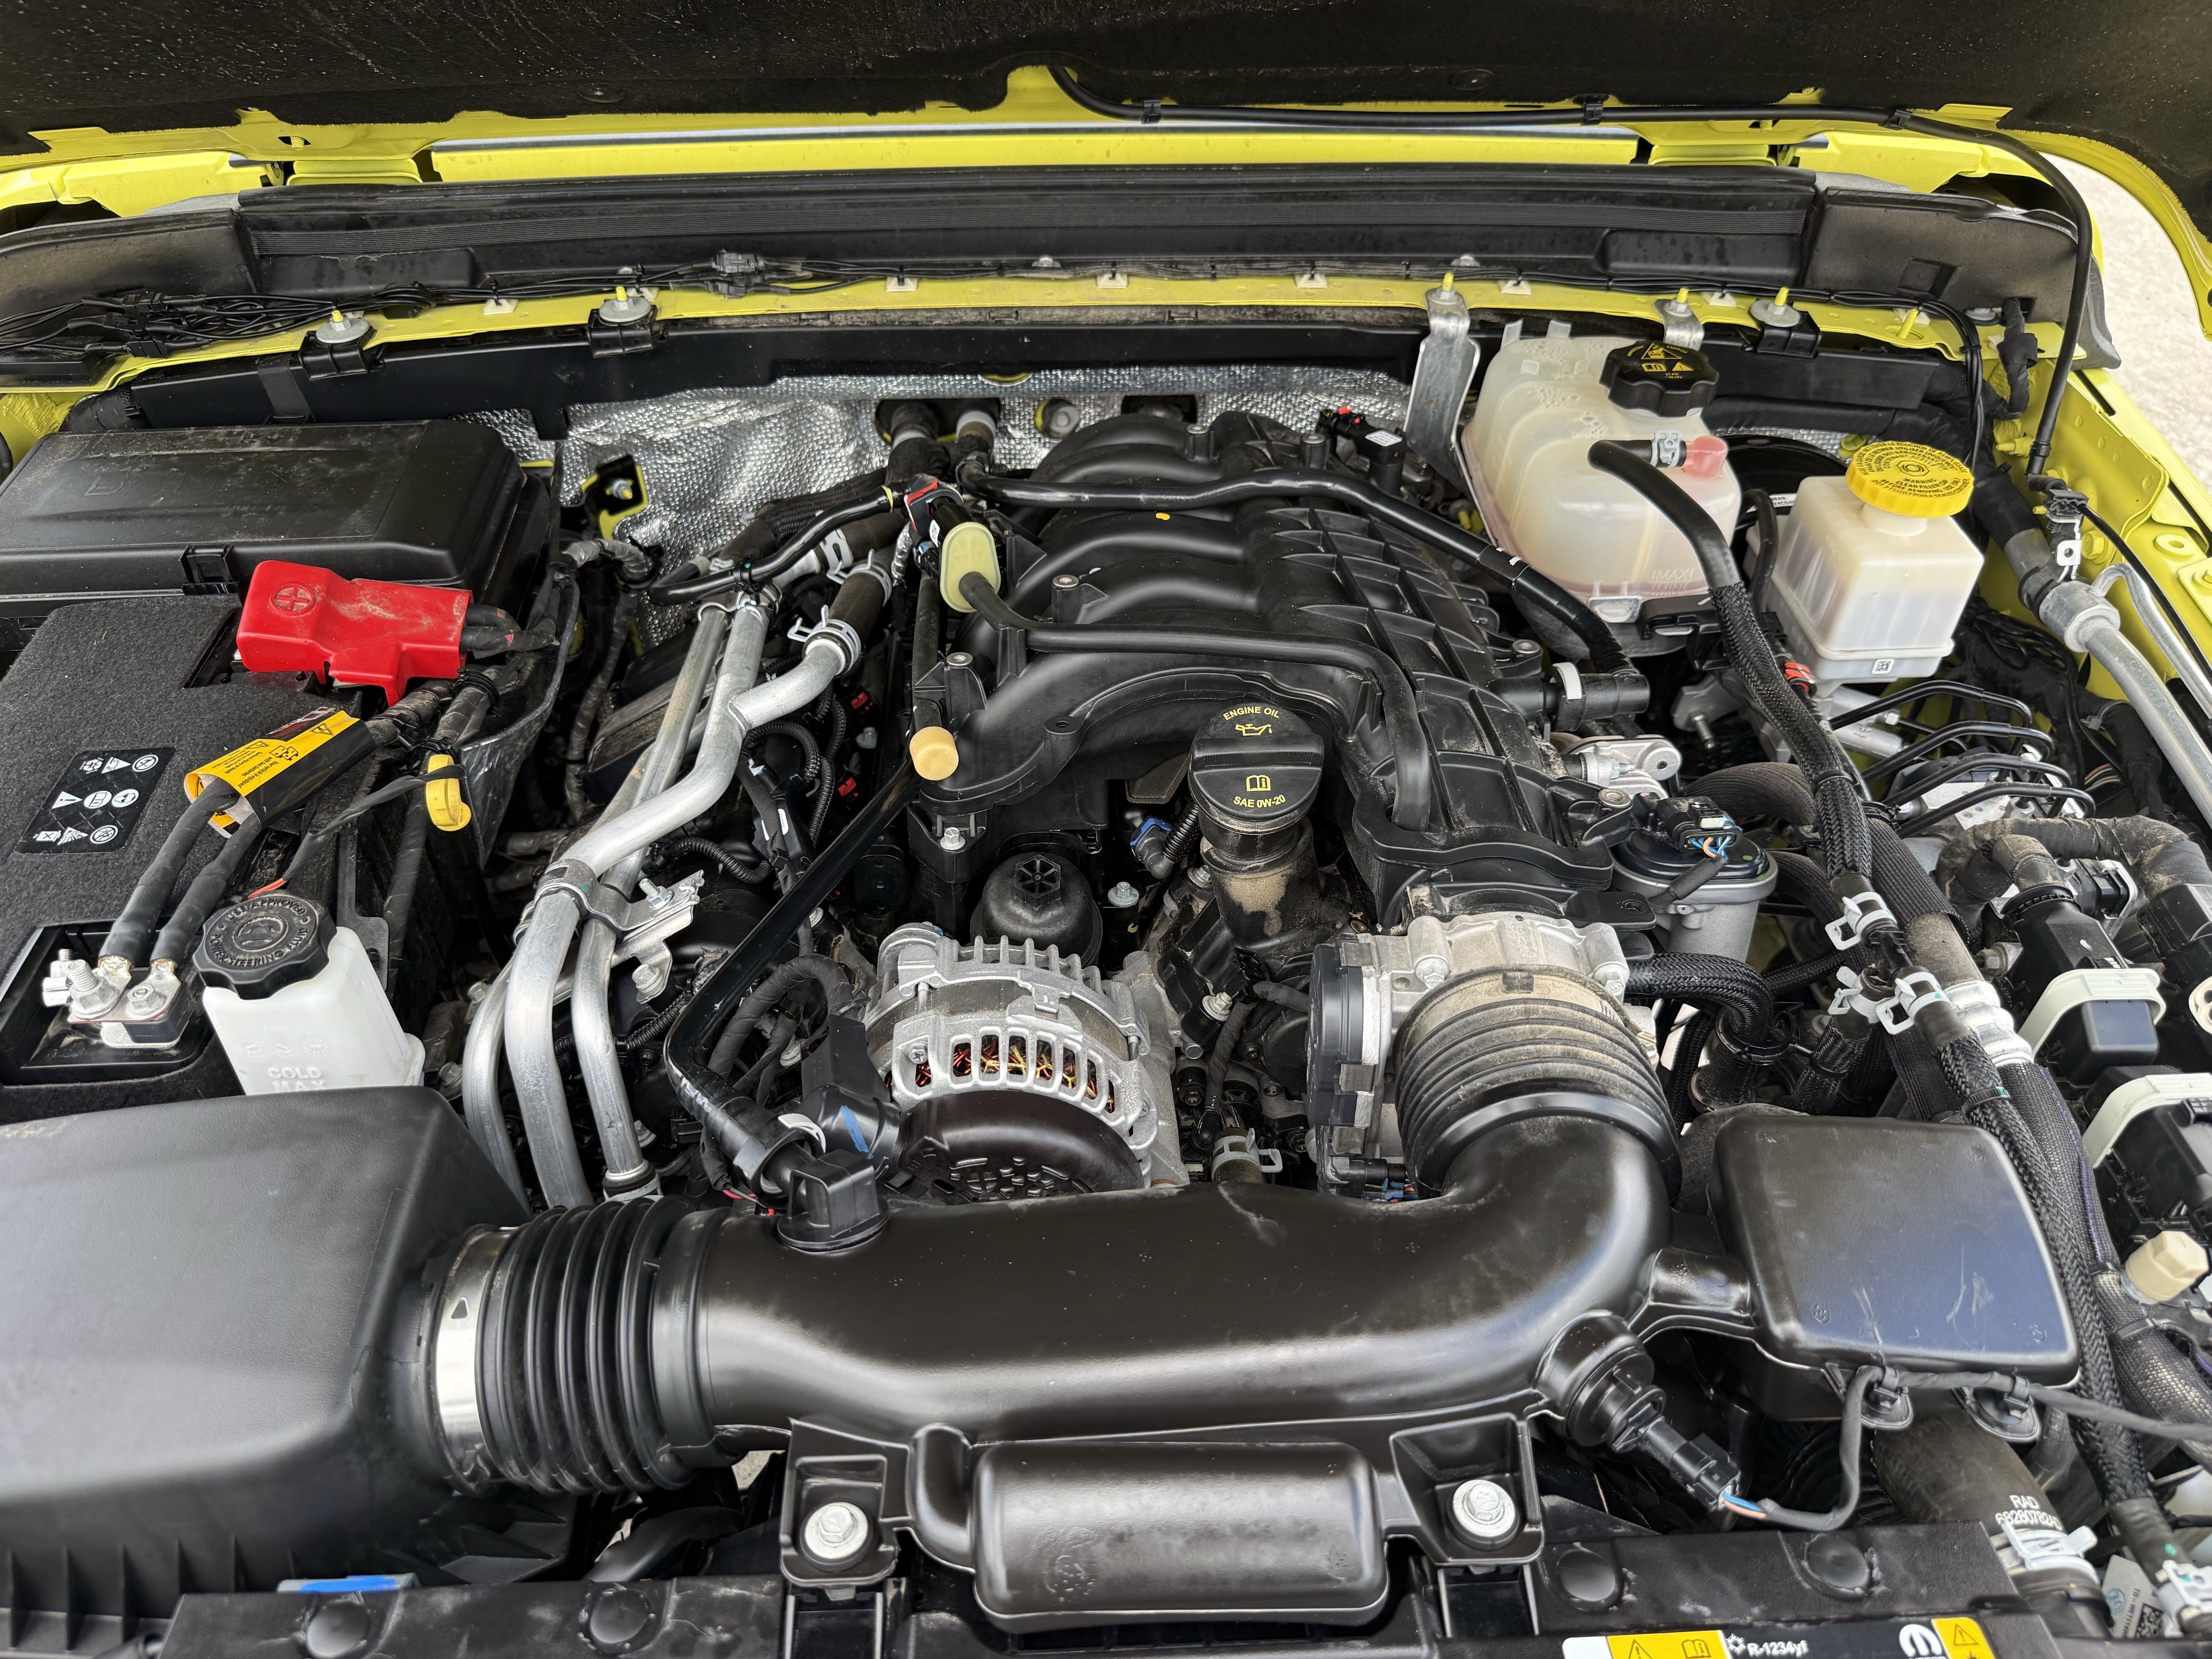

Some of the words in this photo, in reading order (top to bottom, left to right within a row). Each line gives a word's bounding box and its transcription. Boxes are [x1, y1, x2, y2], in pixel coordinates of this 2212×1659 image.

[1925, 451, 1957, 470] UNIQUEMENT
[1880, 479, 1905, 489] BEFORE
[1223, 706, 1261, 720] ENGINE
[1264, 708, 1279, 718] OIL
[238, 775, 255, 788] equipped
[1233, 796, 1255, 808] SAE
[1256, 795, 1286, 808] 0W-20
[224, 906, 248, 921] USE
[251, 898, 307, 915] APPROVED
[229, 950, 285, 967] STEERING
[285, 927, 309, 951] FLUID
[267, 1067, 321, 1079] COLD
[271, 1080, 325, 1094] MAX
[2009, 1495, 2040, 1510] RAD
[1747, 1640, 1809, 1658] R-1234yf
